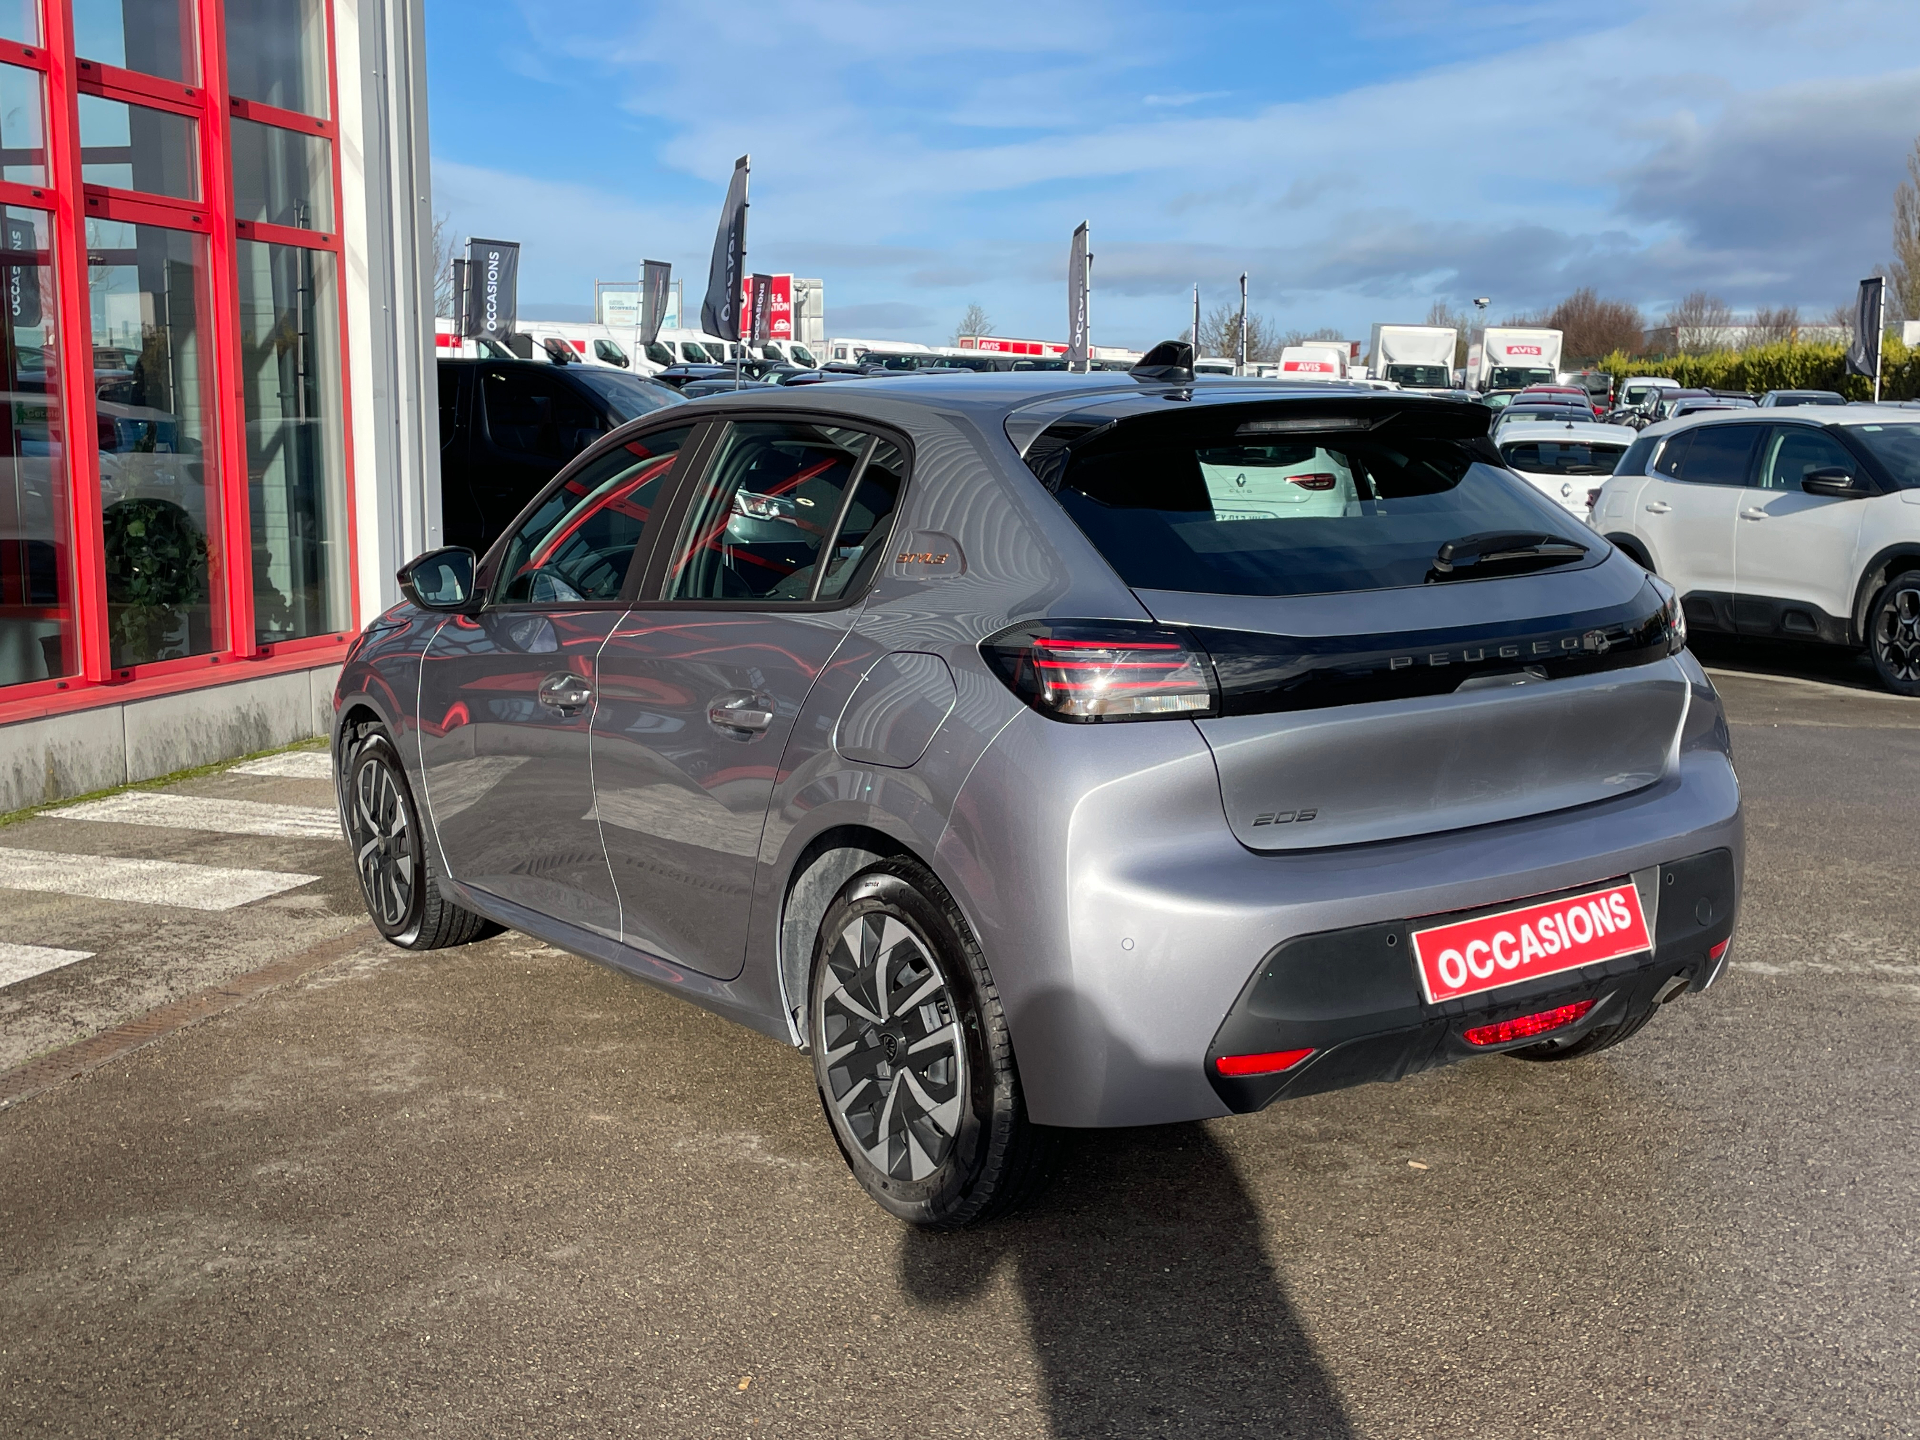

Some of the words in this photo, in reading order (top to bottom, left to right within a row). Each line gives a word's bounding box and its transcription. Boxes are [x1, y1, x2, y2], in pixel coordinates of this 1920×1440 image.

[12, 230, 22, 316] OCCASNS
[486, 251, 500, 332] OCCASIONS
[754, 282, 766, 341] OCCASIONS
[980, 341, 1000, 351] AVIS
[1510, 346, 1539, 354] AVIS
[1296, 362, 1321, 372] AVIS
[896, 552, 949, 565] STYLE
[1251, 808, 1318, 827] 208
[1438, 892, 1632, 989] OCCASIONS
